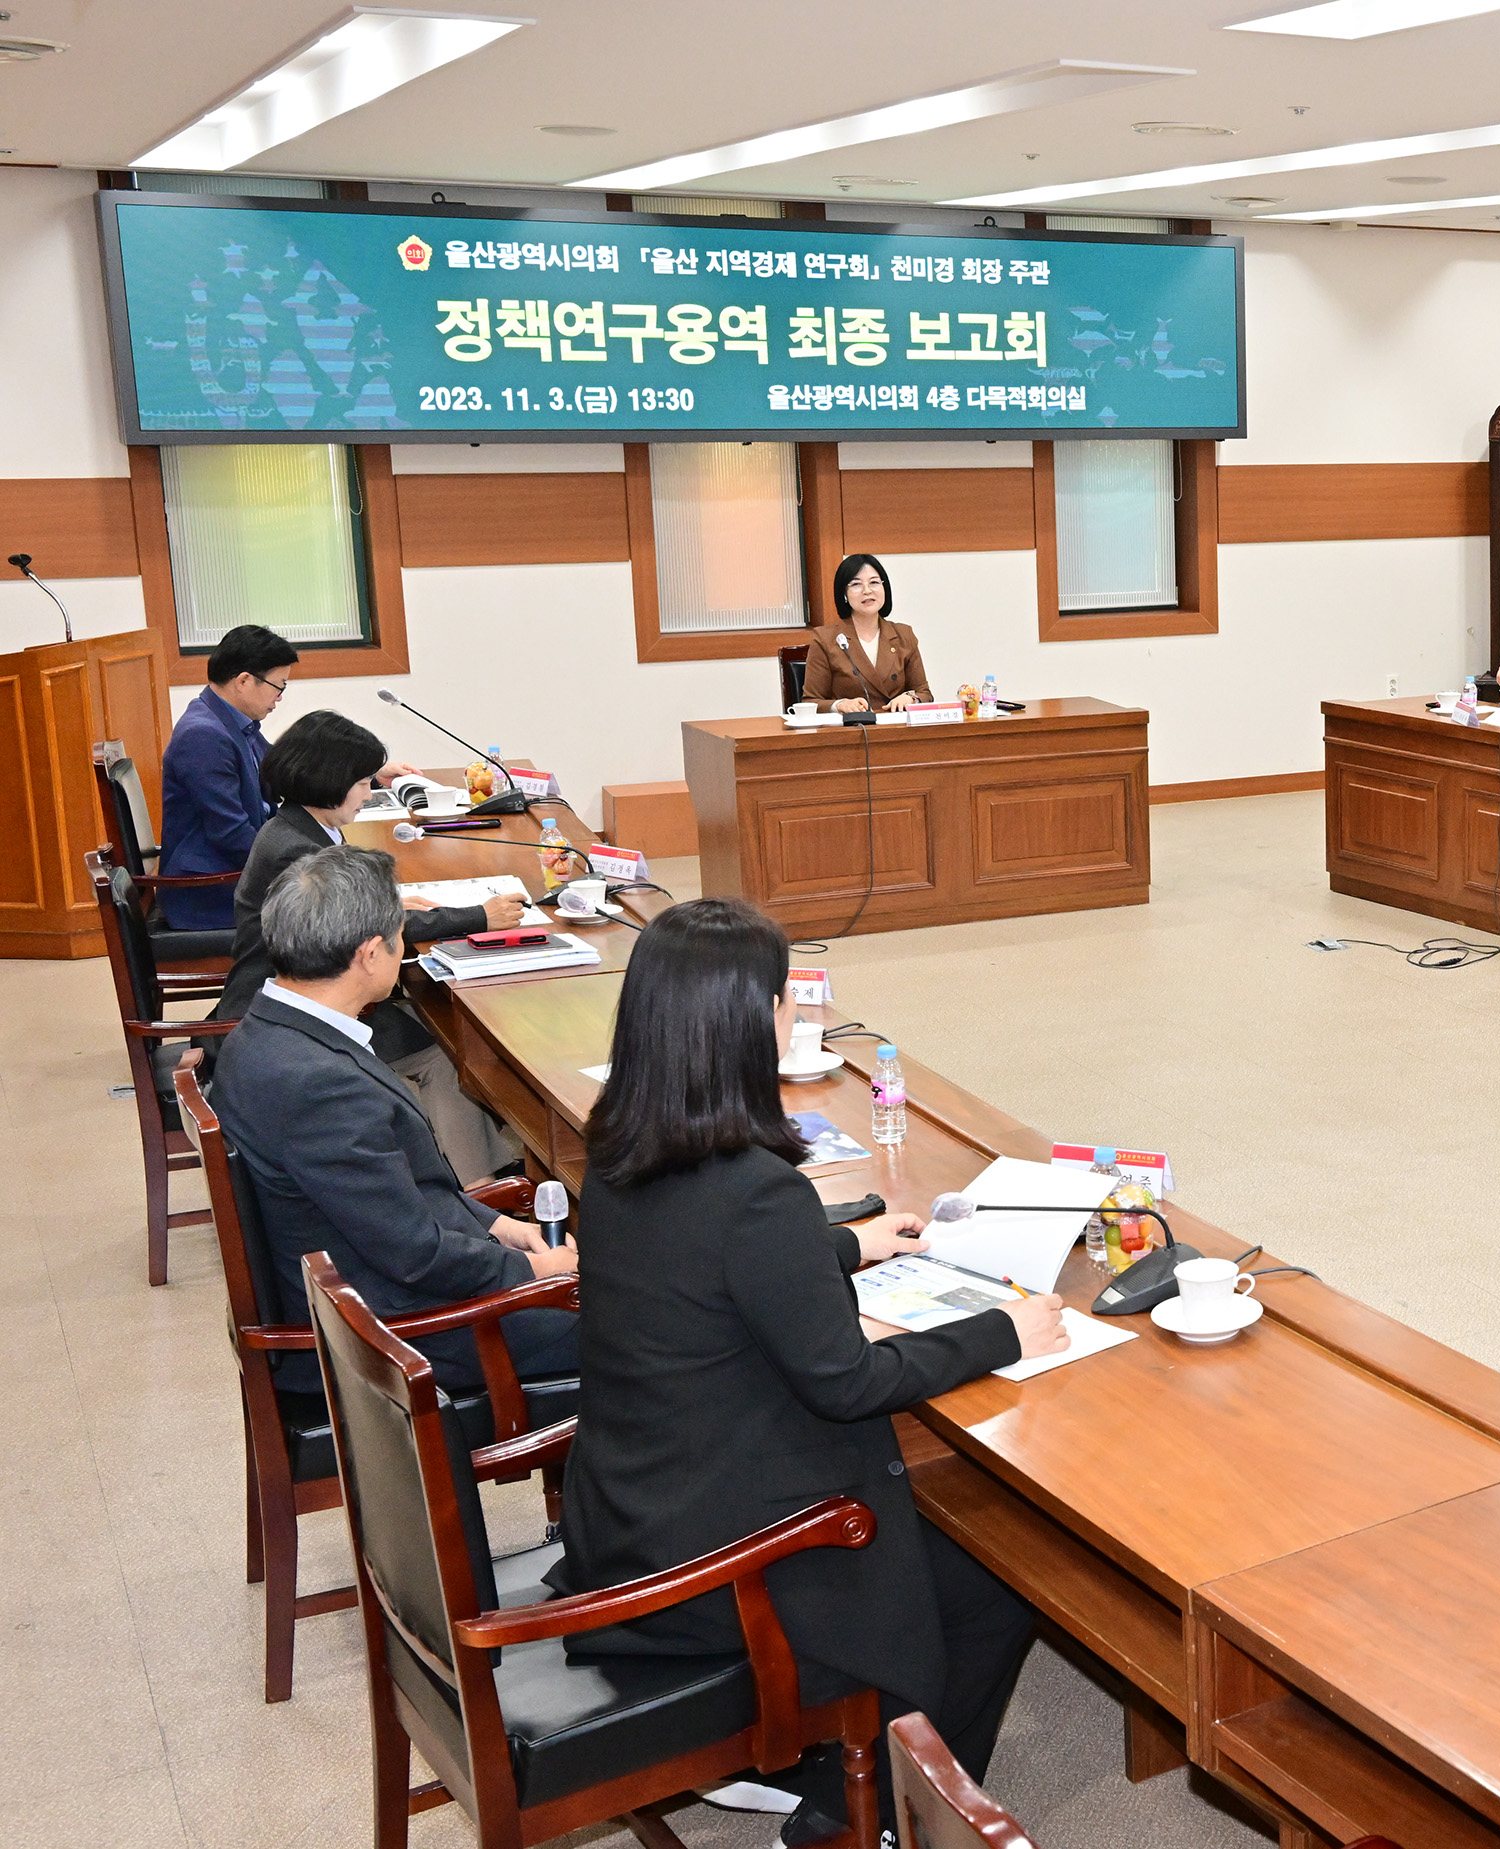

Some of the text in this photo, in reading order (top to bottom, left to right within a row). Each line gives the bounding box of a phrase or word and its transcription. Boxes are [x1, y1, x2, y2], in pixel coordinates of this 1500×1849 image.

[445, 240, 1052, 287] 울산광역시의회 「울산 지역경제 연구회」 천미경 회장 주관
[435, 298, 1048, 369] 정책연구용역 최종 보고회
[419, 385, 695, 415] 2023. 11. 3.(금) 13:30
[767, 385, 1087, 412] 울산광역시의회 4층 다목적회의실
